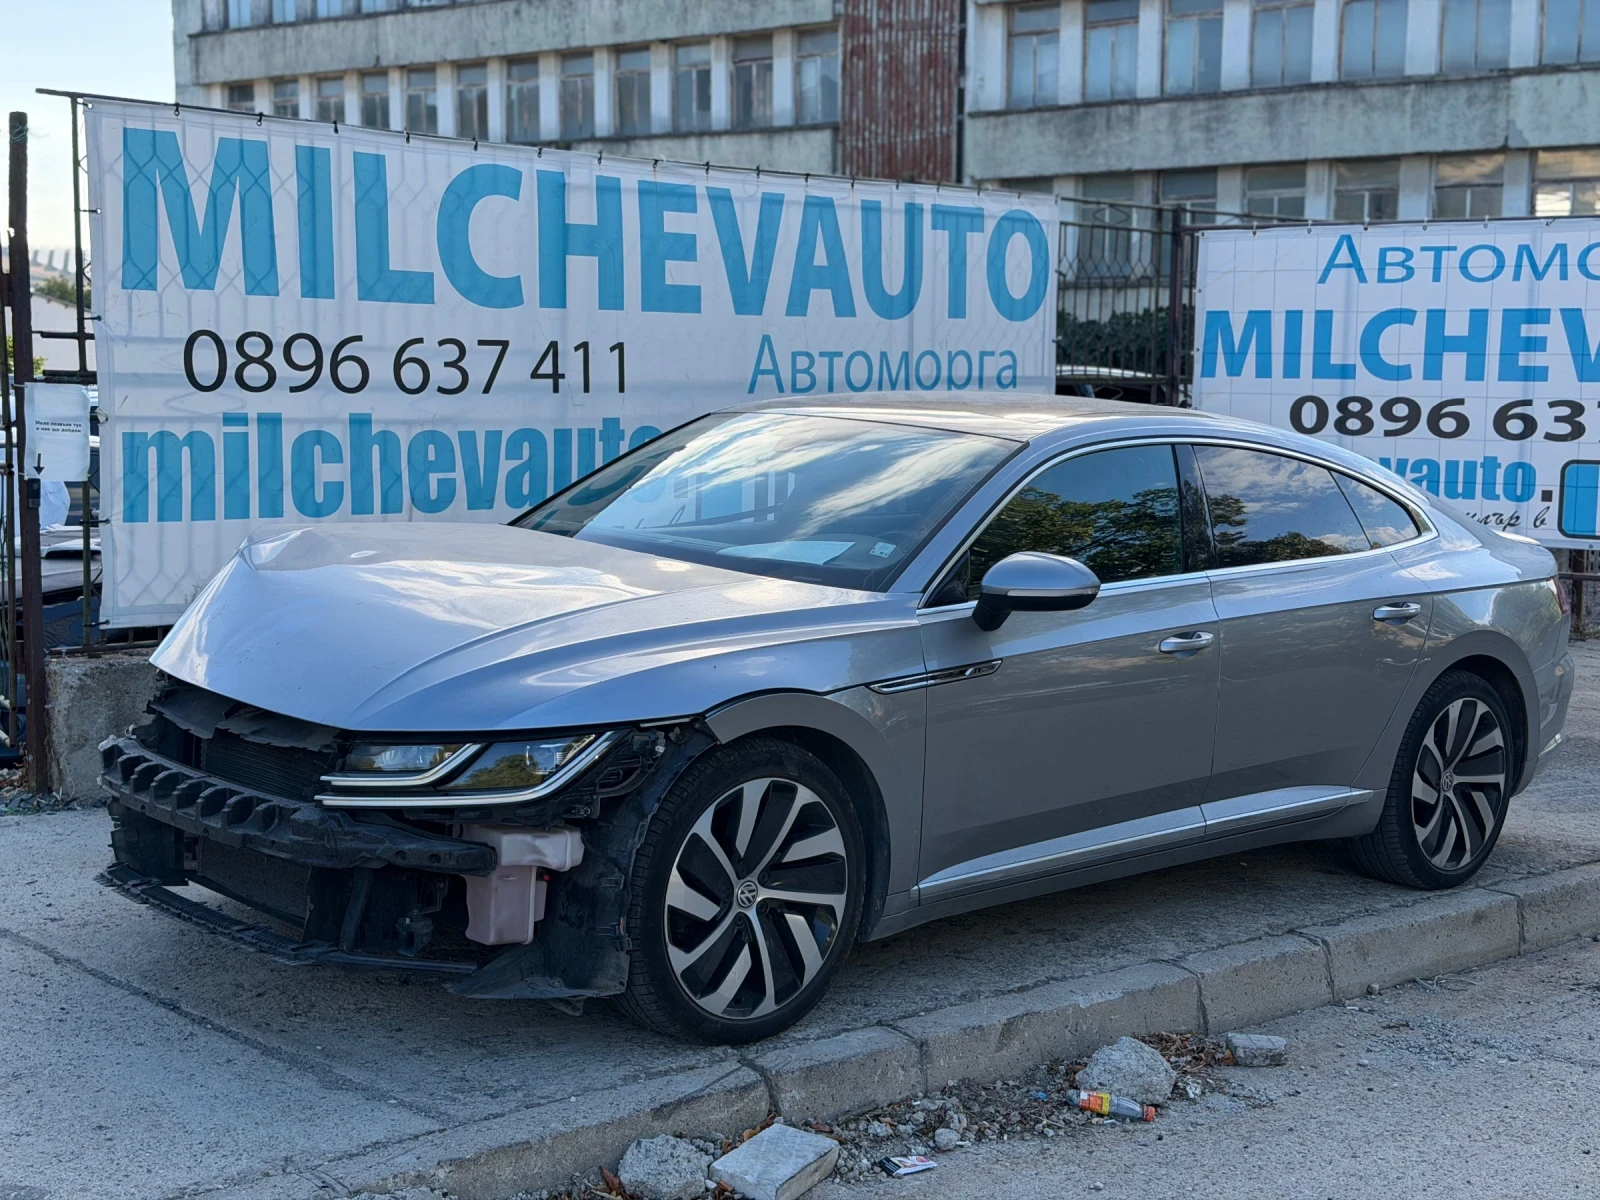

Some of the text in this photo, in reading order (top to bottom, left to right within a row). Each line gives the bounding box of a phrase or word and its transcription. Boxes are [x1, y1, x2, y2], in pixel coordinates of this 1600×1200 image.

[121, 128, 1051, 323] MILCHEVAUTO
[184, 330, 626, 396] 0896 637 411
[748, 334, 1018, 392] Автоморга
[1200, 305, 1600, 384] MILCHEV
[1290, 395, 1600, 443] 0896 63
